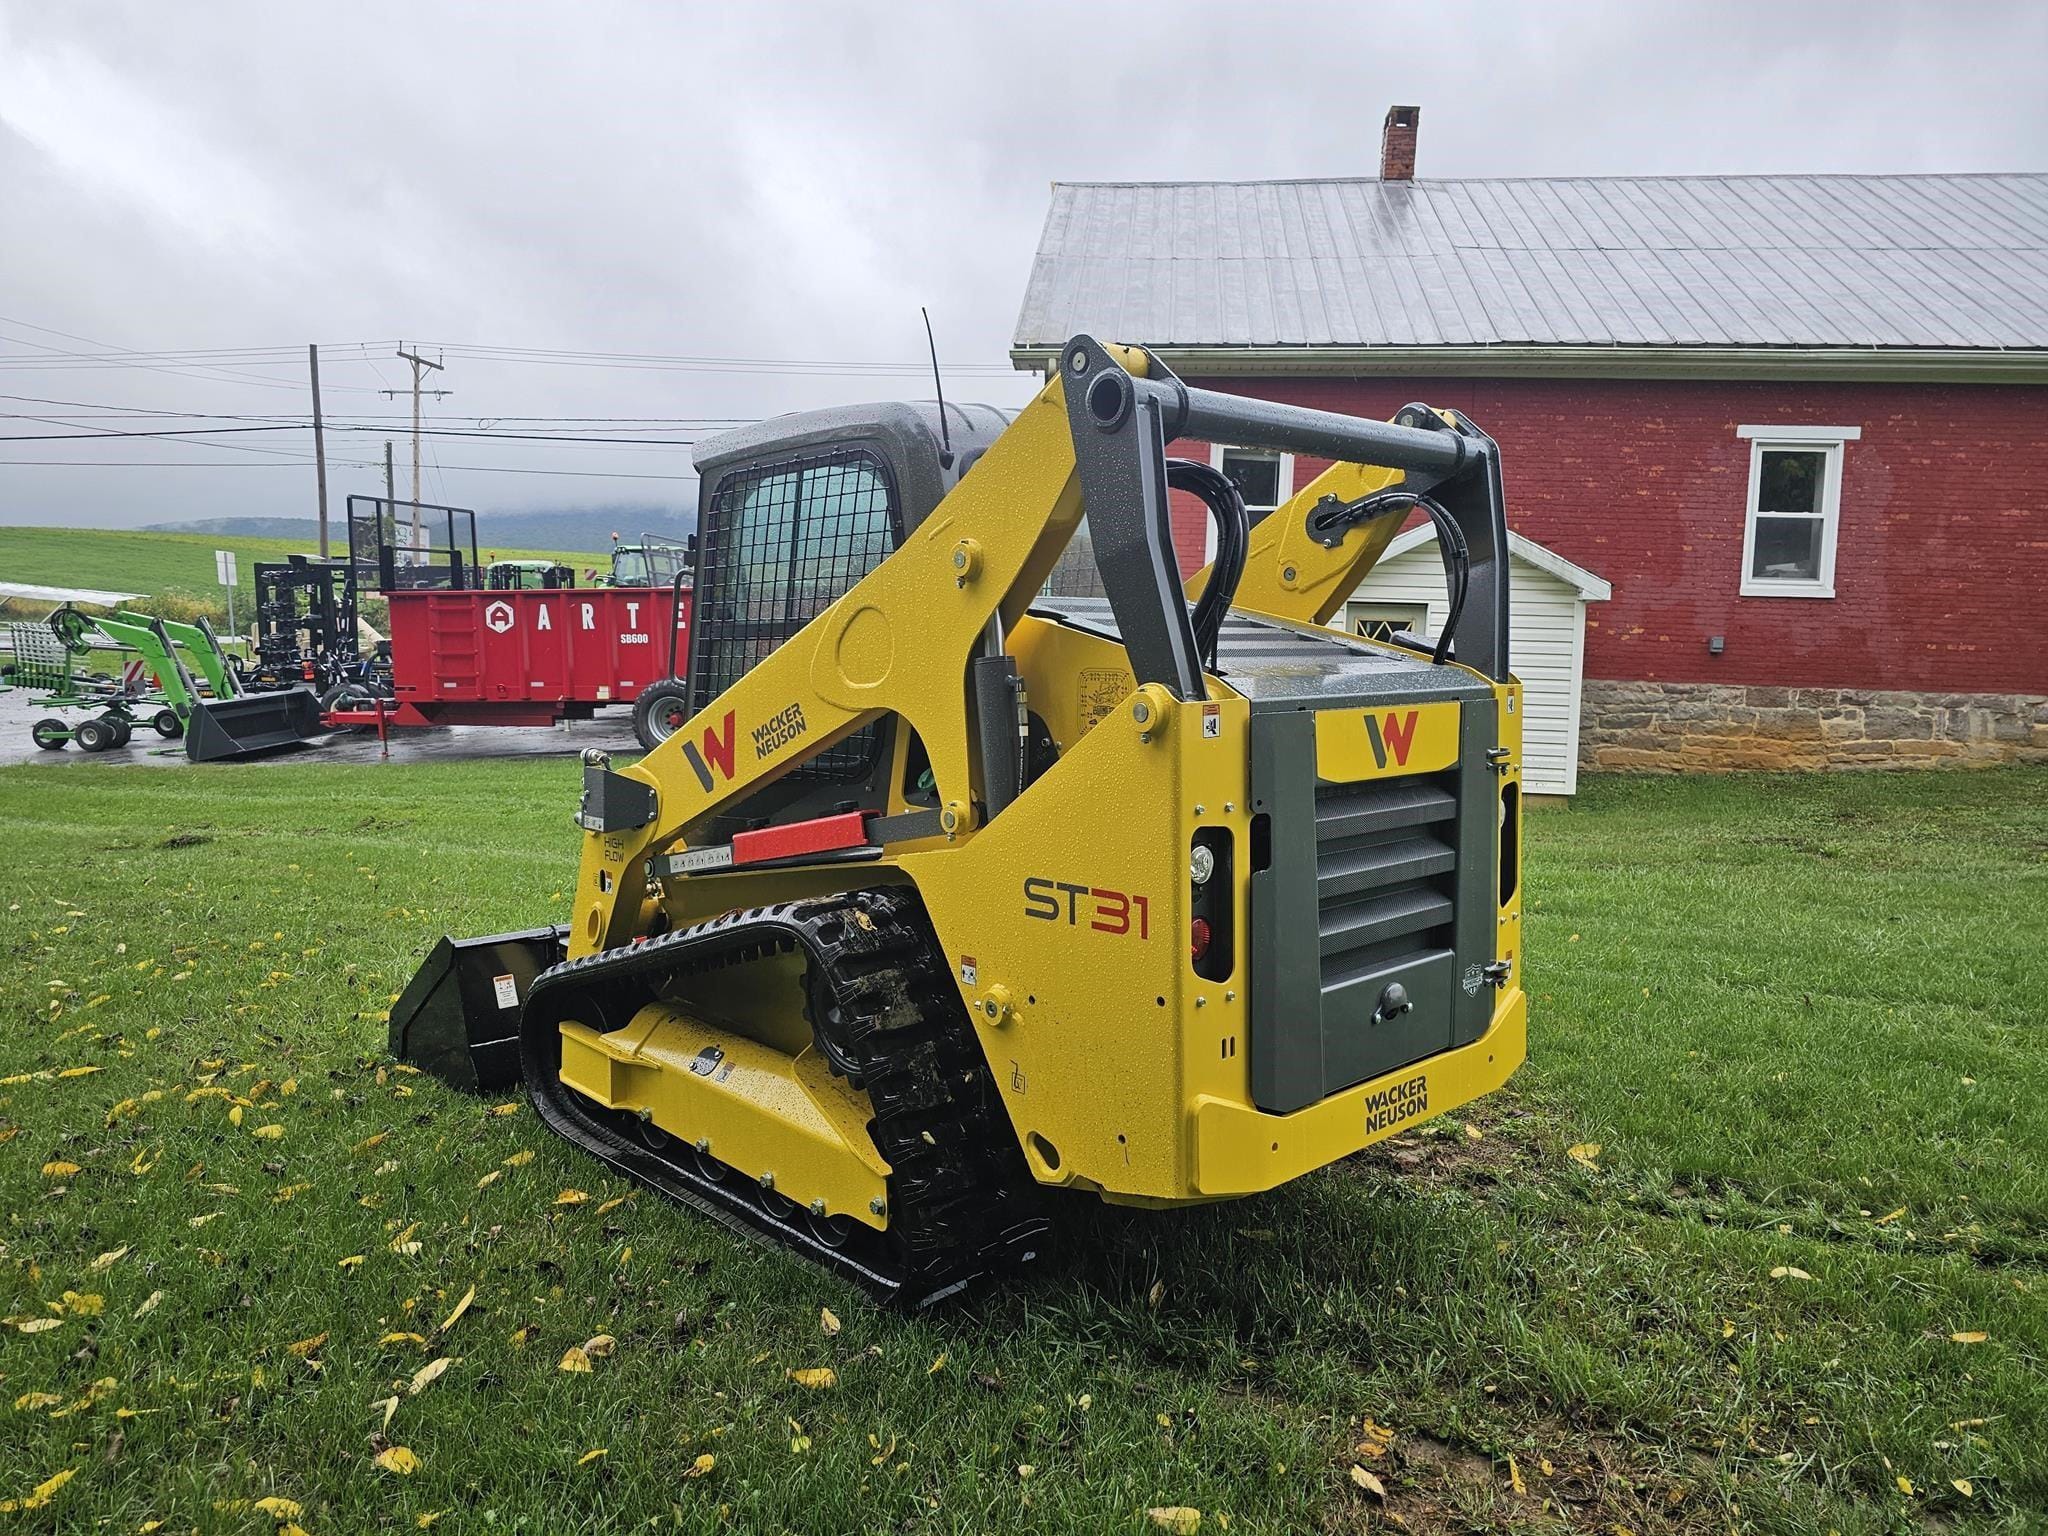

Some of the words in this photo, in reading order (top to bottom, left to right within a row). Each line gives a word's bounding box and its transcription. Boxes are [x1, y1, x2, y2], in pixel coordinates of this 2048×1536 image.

[620, 633, 649, 644] SB600
[751, 702, 803, 744] WACKER
[755, 716, 807, 760] NEUSON
[604, 837, 625, 849] HIGH
[604, 850, 625, 863] FLOW
[1023, 877, 1148, 940] ST31
[1364, 1075, 1427, 1114] WACKER
[1366, 1093, 1428, 1135] NEUSON
